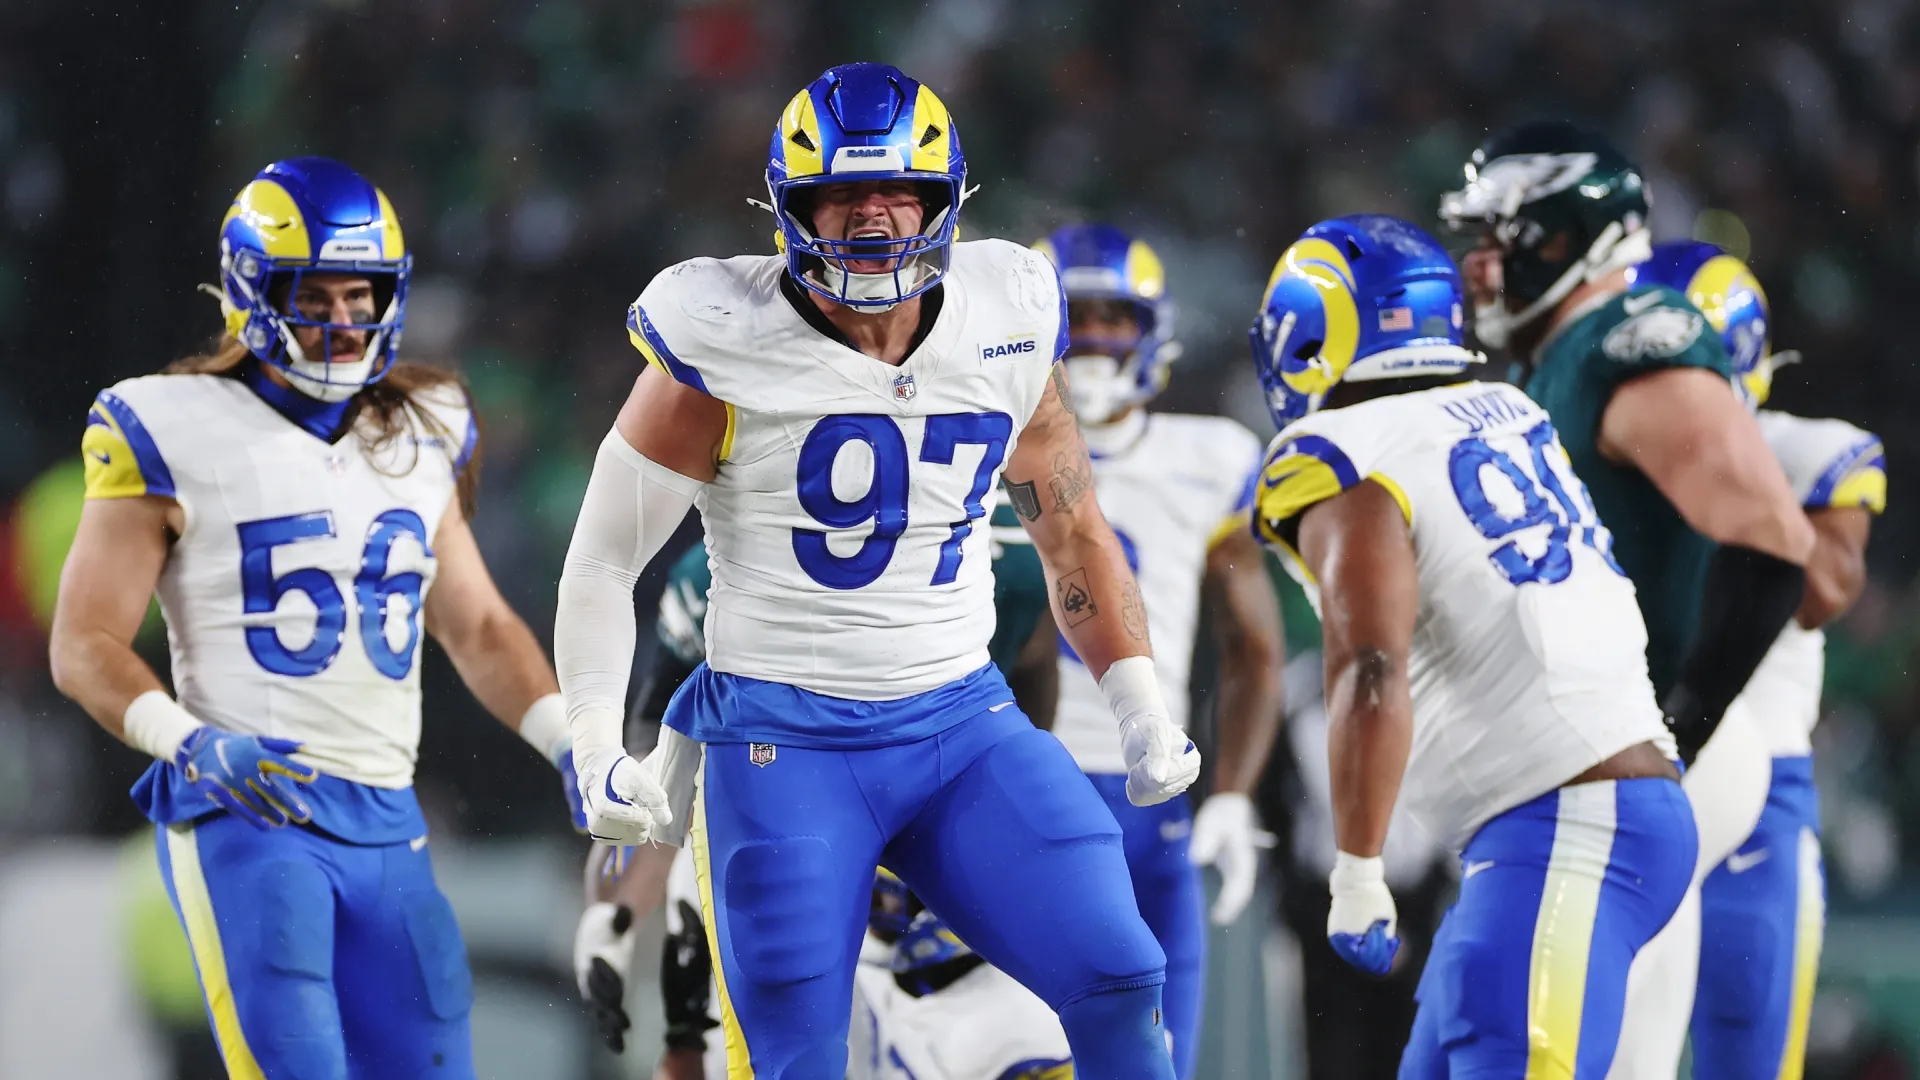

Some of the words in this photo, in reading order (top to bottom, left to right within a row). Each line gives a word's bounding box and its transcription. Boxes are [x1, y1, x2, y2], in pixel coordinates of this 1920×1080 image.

[846, 148, 887, 158] RAMS
[982, 340, 1036, 360] RAMS
[896, 384, 914, 397] NFL
[791, 411, 1014, 591] 97
[235, 507, 435, 681] 56
[752, 750, 772, 762] NFL
